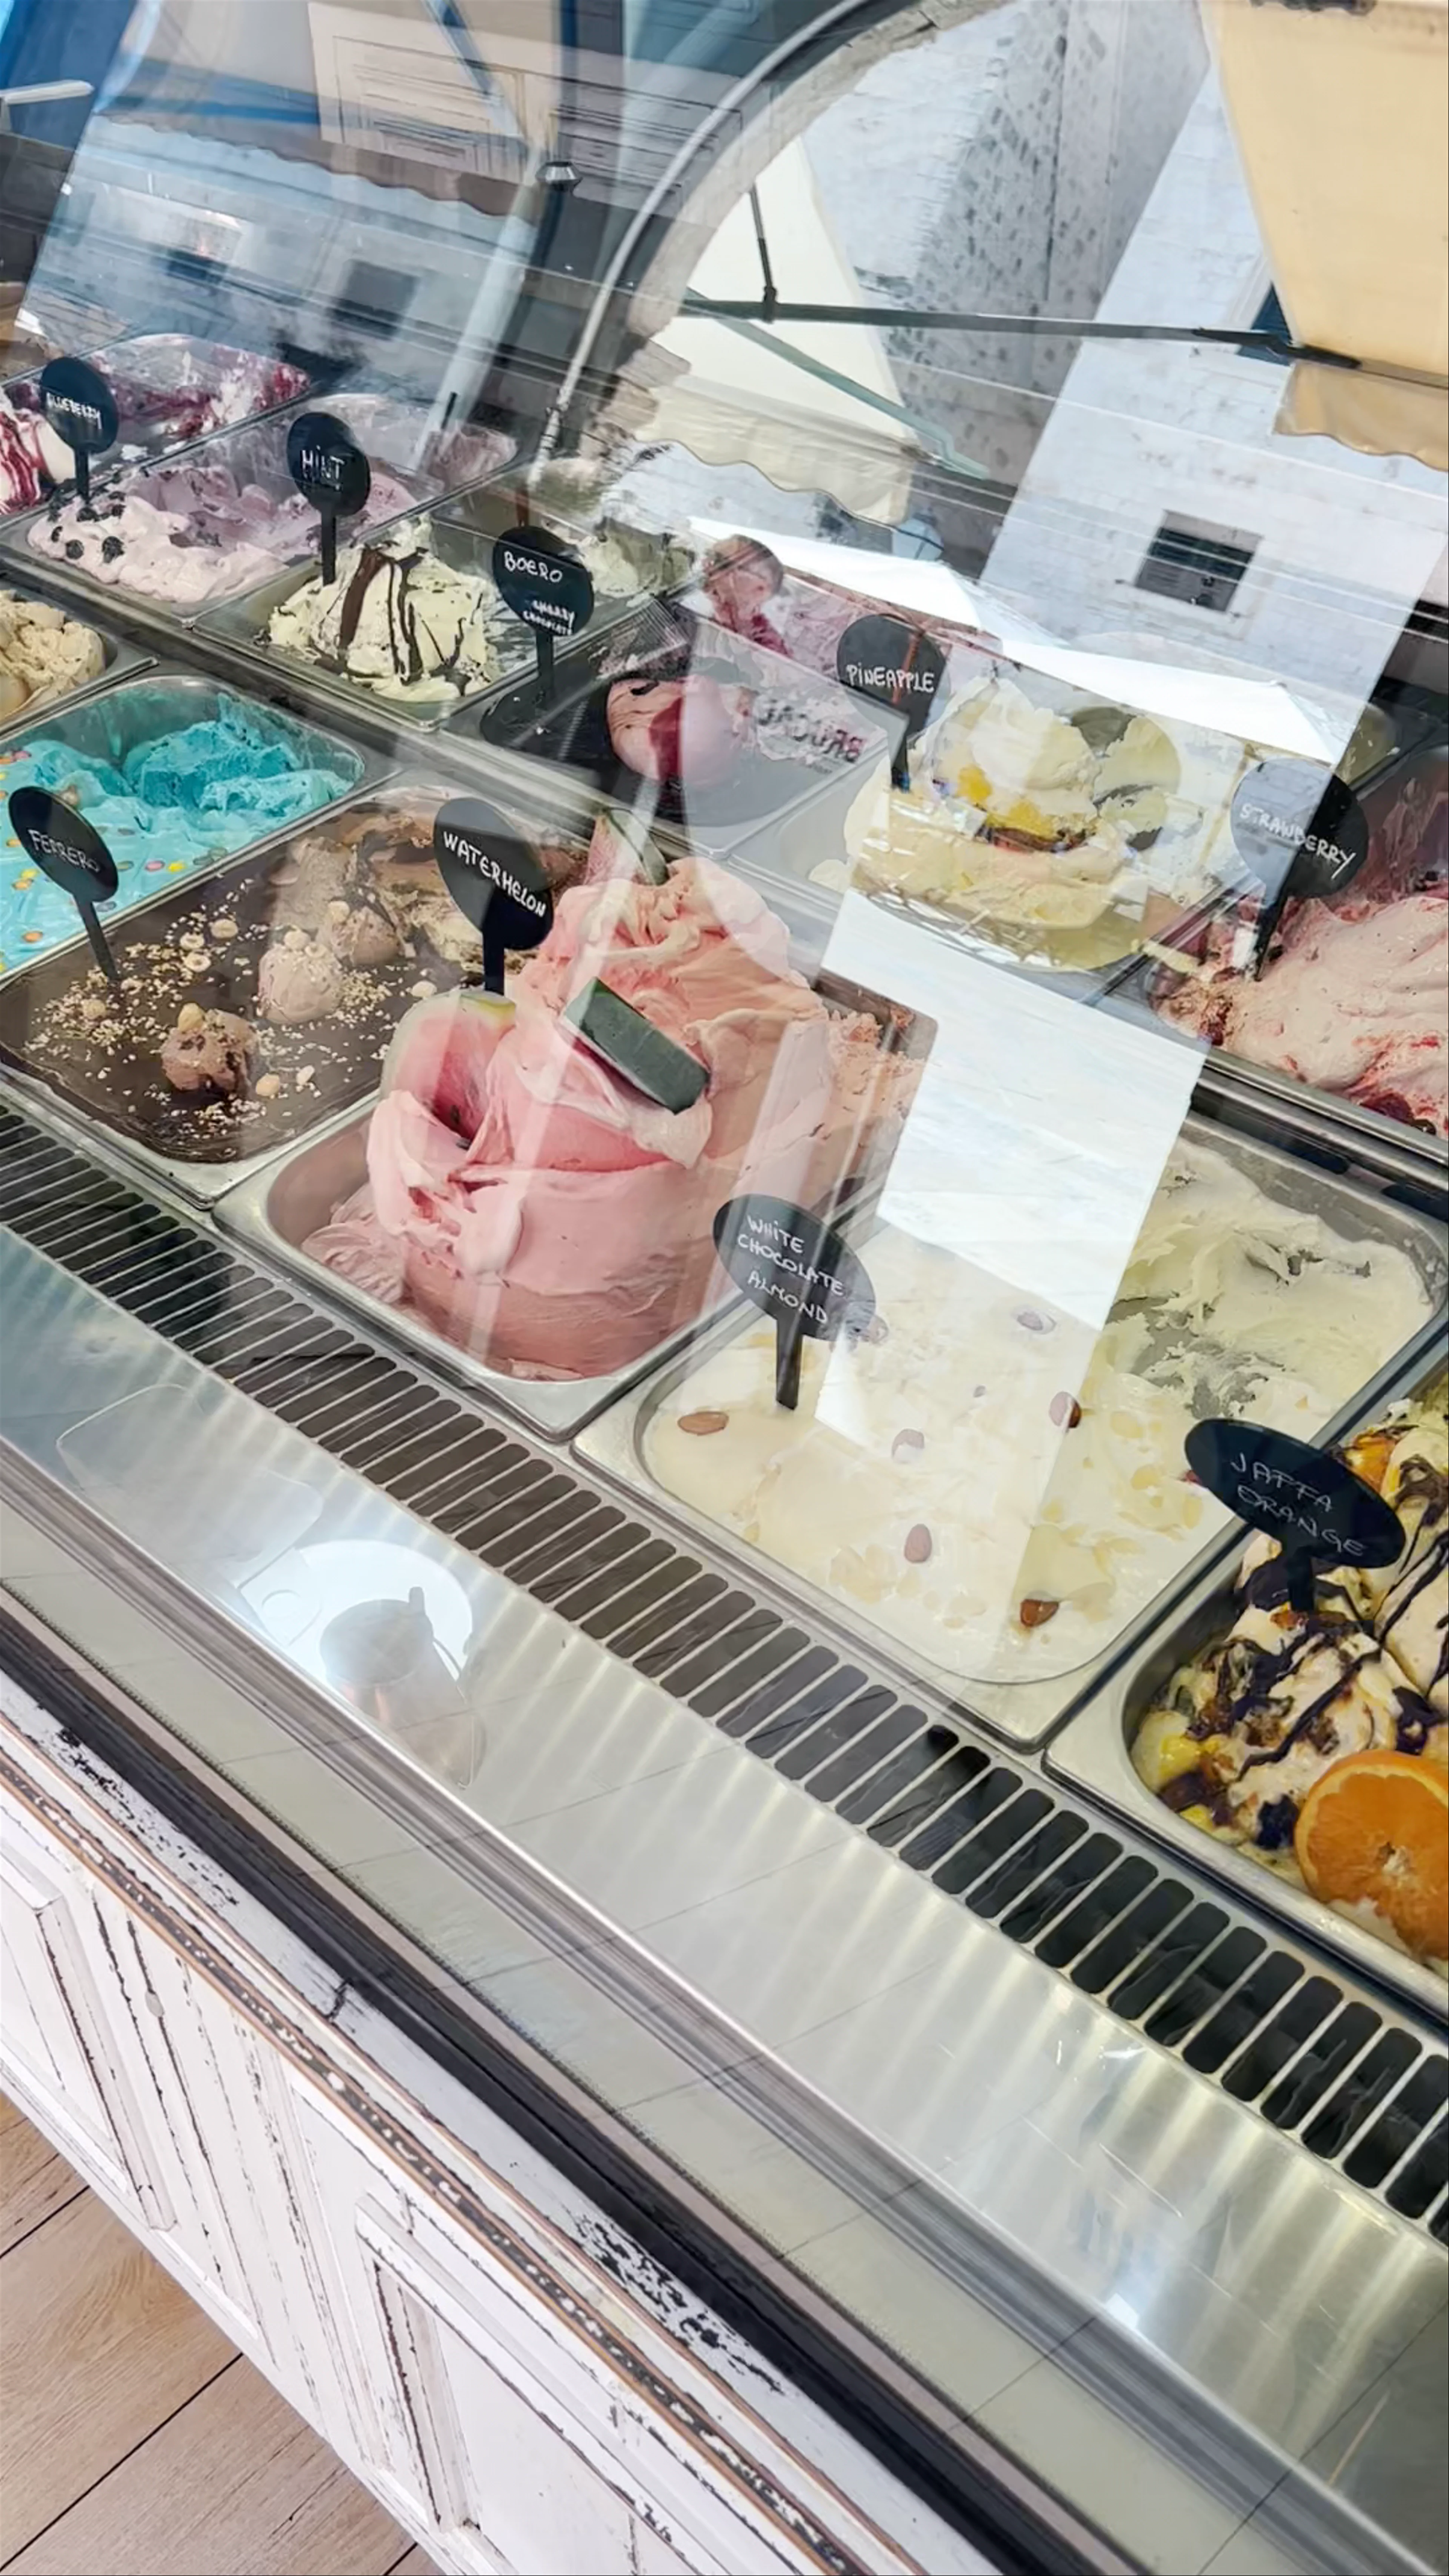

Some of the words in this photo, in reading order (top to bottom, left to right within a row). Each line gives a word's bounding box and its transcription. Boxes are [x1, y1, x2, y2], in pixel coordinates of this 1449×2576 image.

[504, 551, 563, 583] BOERO
[1239, 803, 1357, 880] STRAWBERRY
[737, 1233, 844, 1296] CHOCOLATE
[748, 1270, 827, 1325] ALMOND
[1230, 1452, 1334, 1512] JAFFA
[1237, 1484, 1364, 1556] ORANGE
